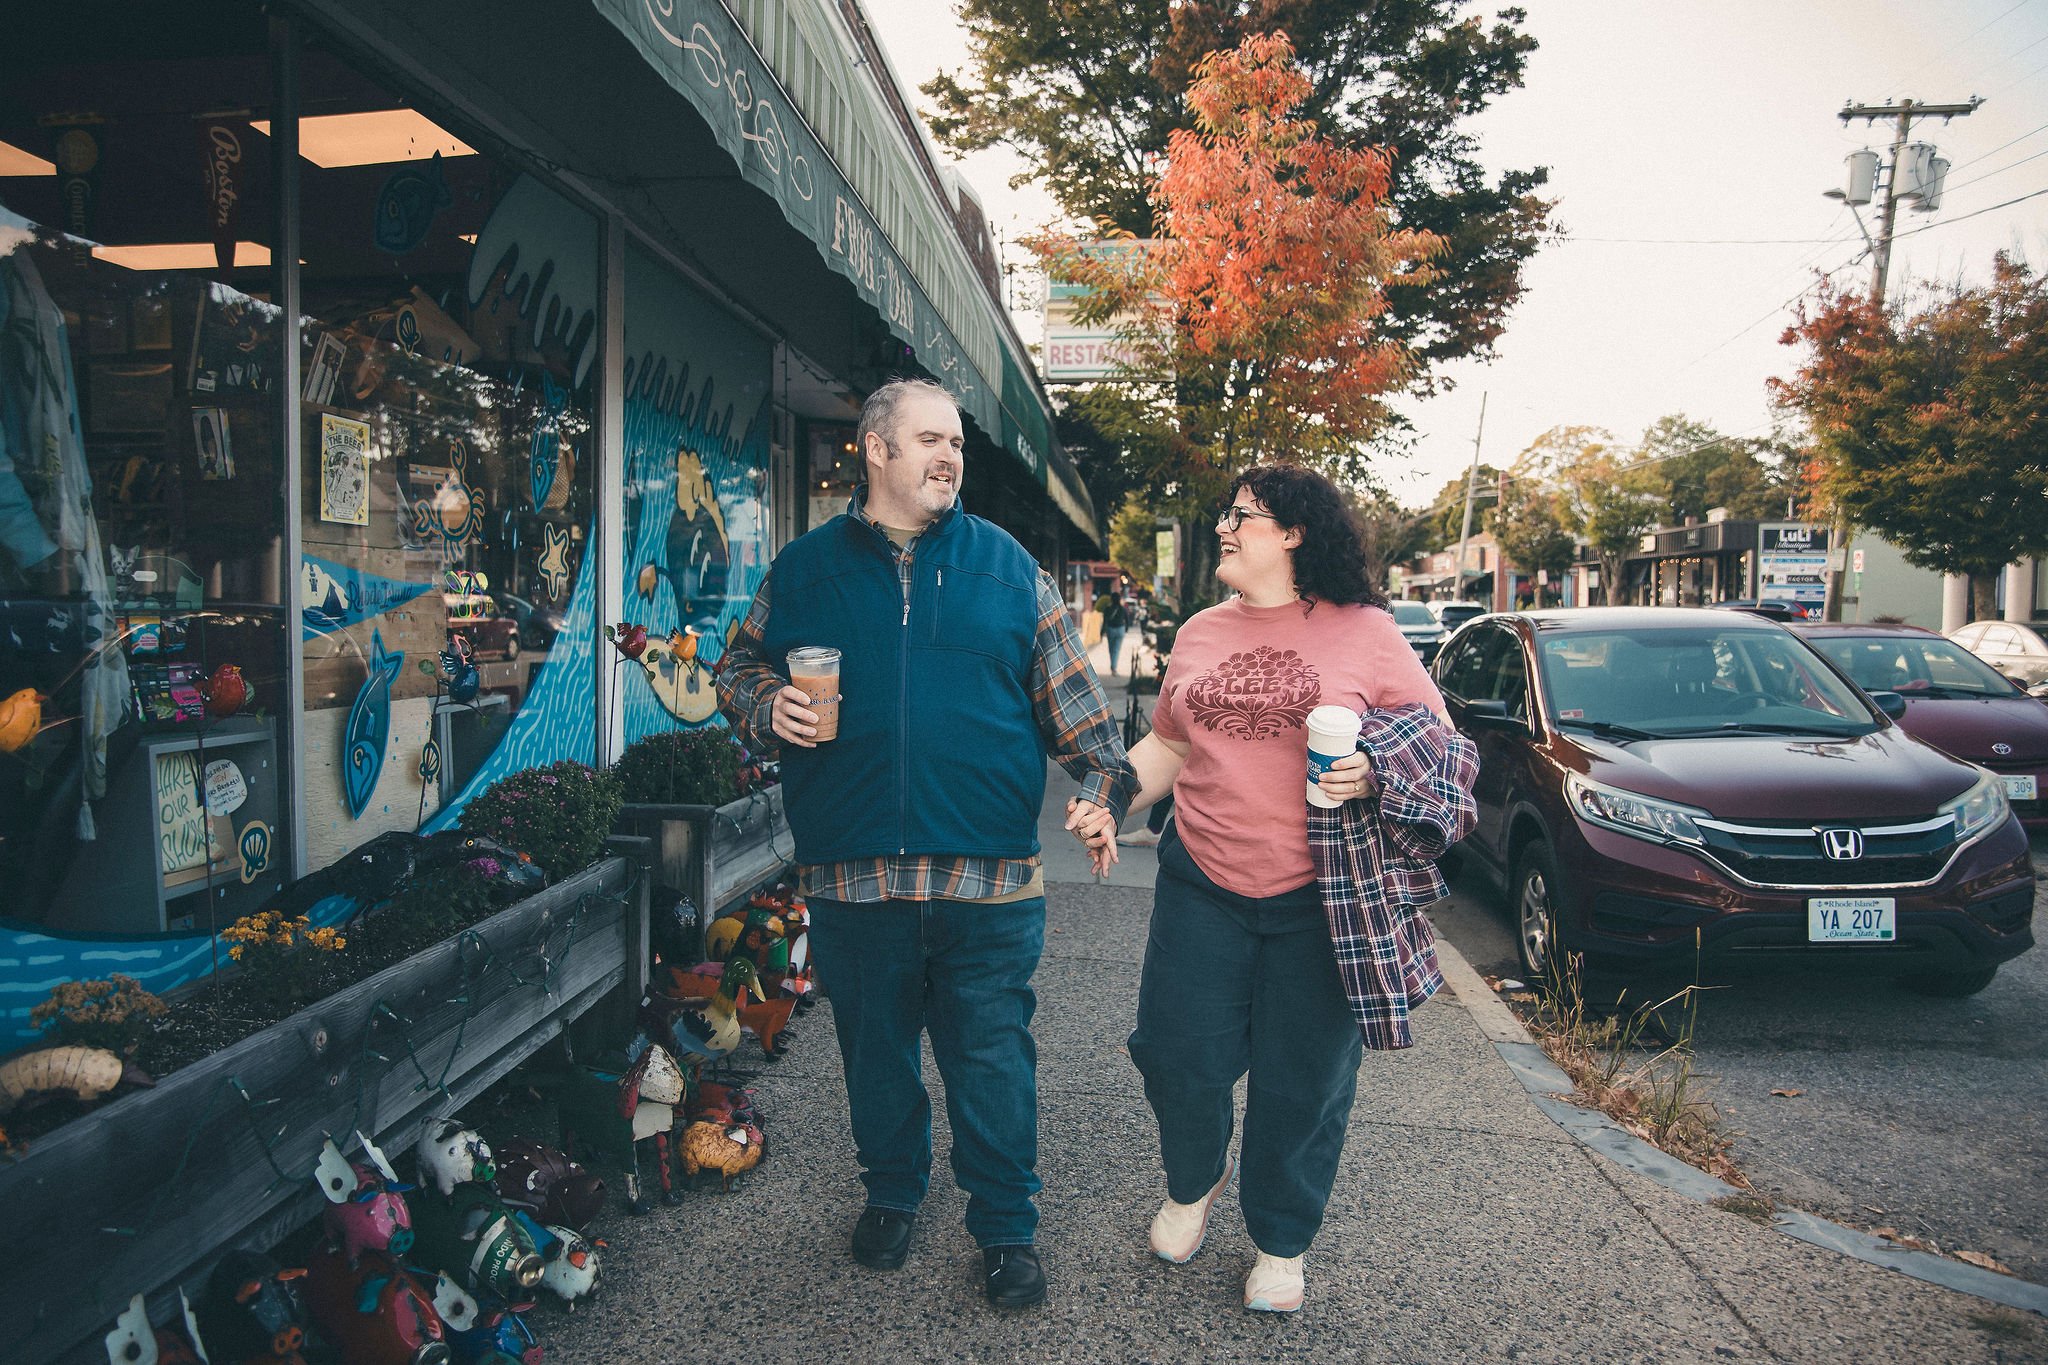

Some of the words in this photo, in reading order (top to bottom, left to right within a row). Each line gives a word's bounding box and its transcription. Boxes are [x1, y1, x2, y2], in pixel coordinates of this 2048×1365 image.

[209, 126, 242, 227] Boston
[831, 194, 875, 292] FROG
[328, 434, 343, 447] THE
[345, 580, 381, 613] Rhode
[380, 581, 413, 608] Island
[1222, 677, 1282, 695] LEE
[2014, 781, 2032, 793] 309
[161, 793, 191, 825] OUR
[1828, 900, 1852, 908] Rhode
[1854, 900, 1875, 908] Island
[1820, 909, 1840, 930] YA
[1852, 909, 1883, 930] 207
[1829, 929, 1852, 938] Ocean
[1854, 930, 1875, 938] State
